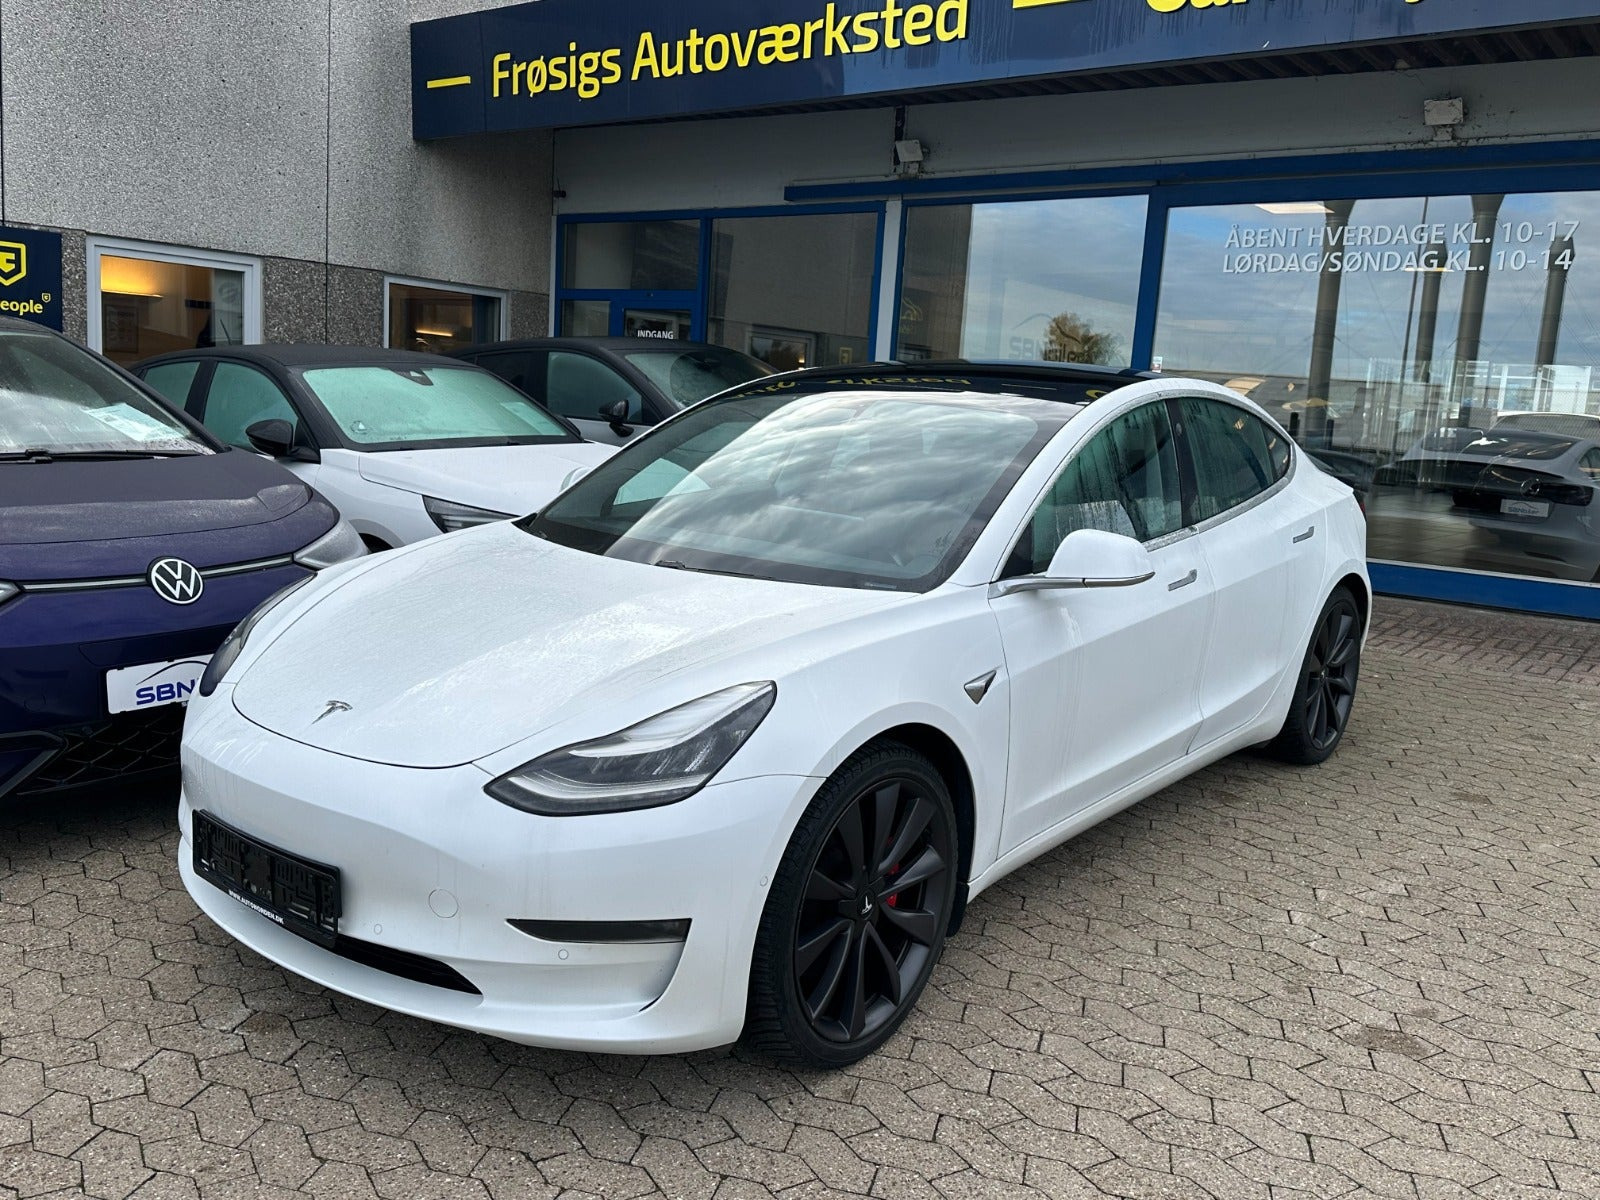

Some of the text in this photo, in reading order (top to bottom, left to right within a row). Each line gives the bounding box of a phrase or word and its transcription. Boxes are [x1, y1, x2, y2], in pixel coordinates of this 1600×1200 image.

[493, 0, 968, 99] Frøsigs Autoværksted
[1224, 220, 1580, 249] ÅBENT HVERDAGE KL. 10-17
[1222, 248, 1573, 274] LØRDAG/SØNDAG KL. 10-14
[637, 329, 674, 340] INDGANG
